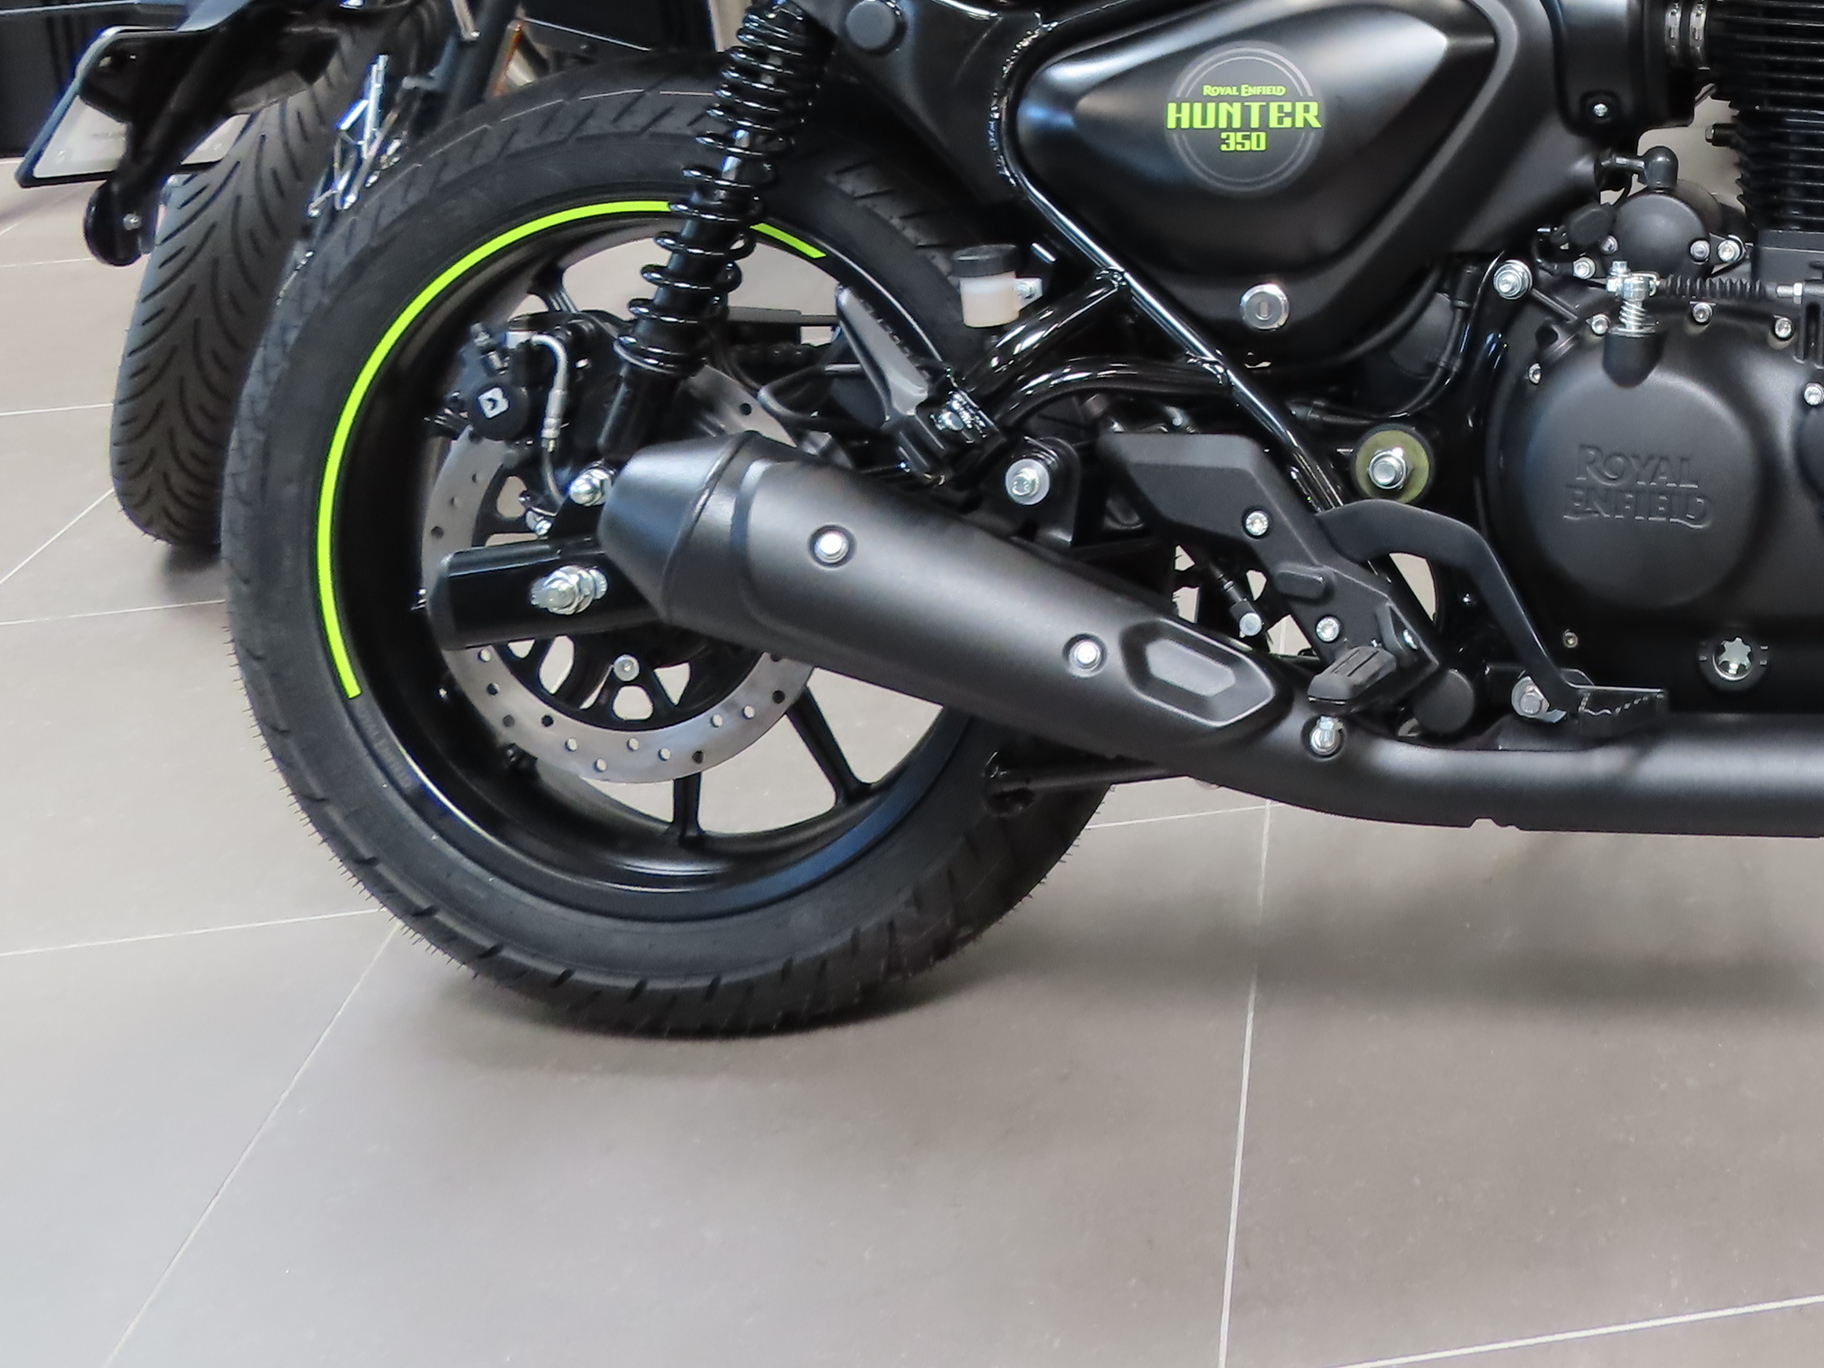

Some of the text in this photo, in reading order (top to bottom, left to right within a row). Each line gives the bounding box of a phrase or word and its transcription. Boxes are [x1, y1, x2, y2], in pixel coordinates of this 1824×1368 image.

[1203, 84, 1287, 97] ROYAL ENFIELD
[1166, 101, 1322, 129] HUNTER
[1219, 131, 1267, 152] 350
[1575, 444, 1699, 489] ROYAL
[1562, 484, 1715, 529] ENFIELD
